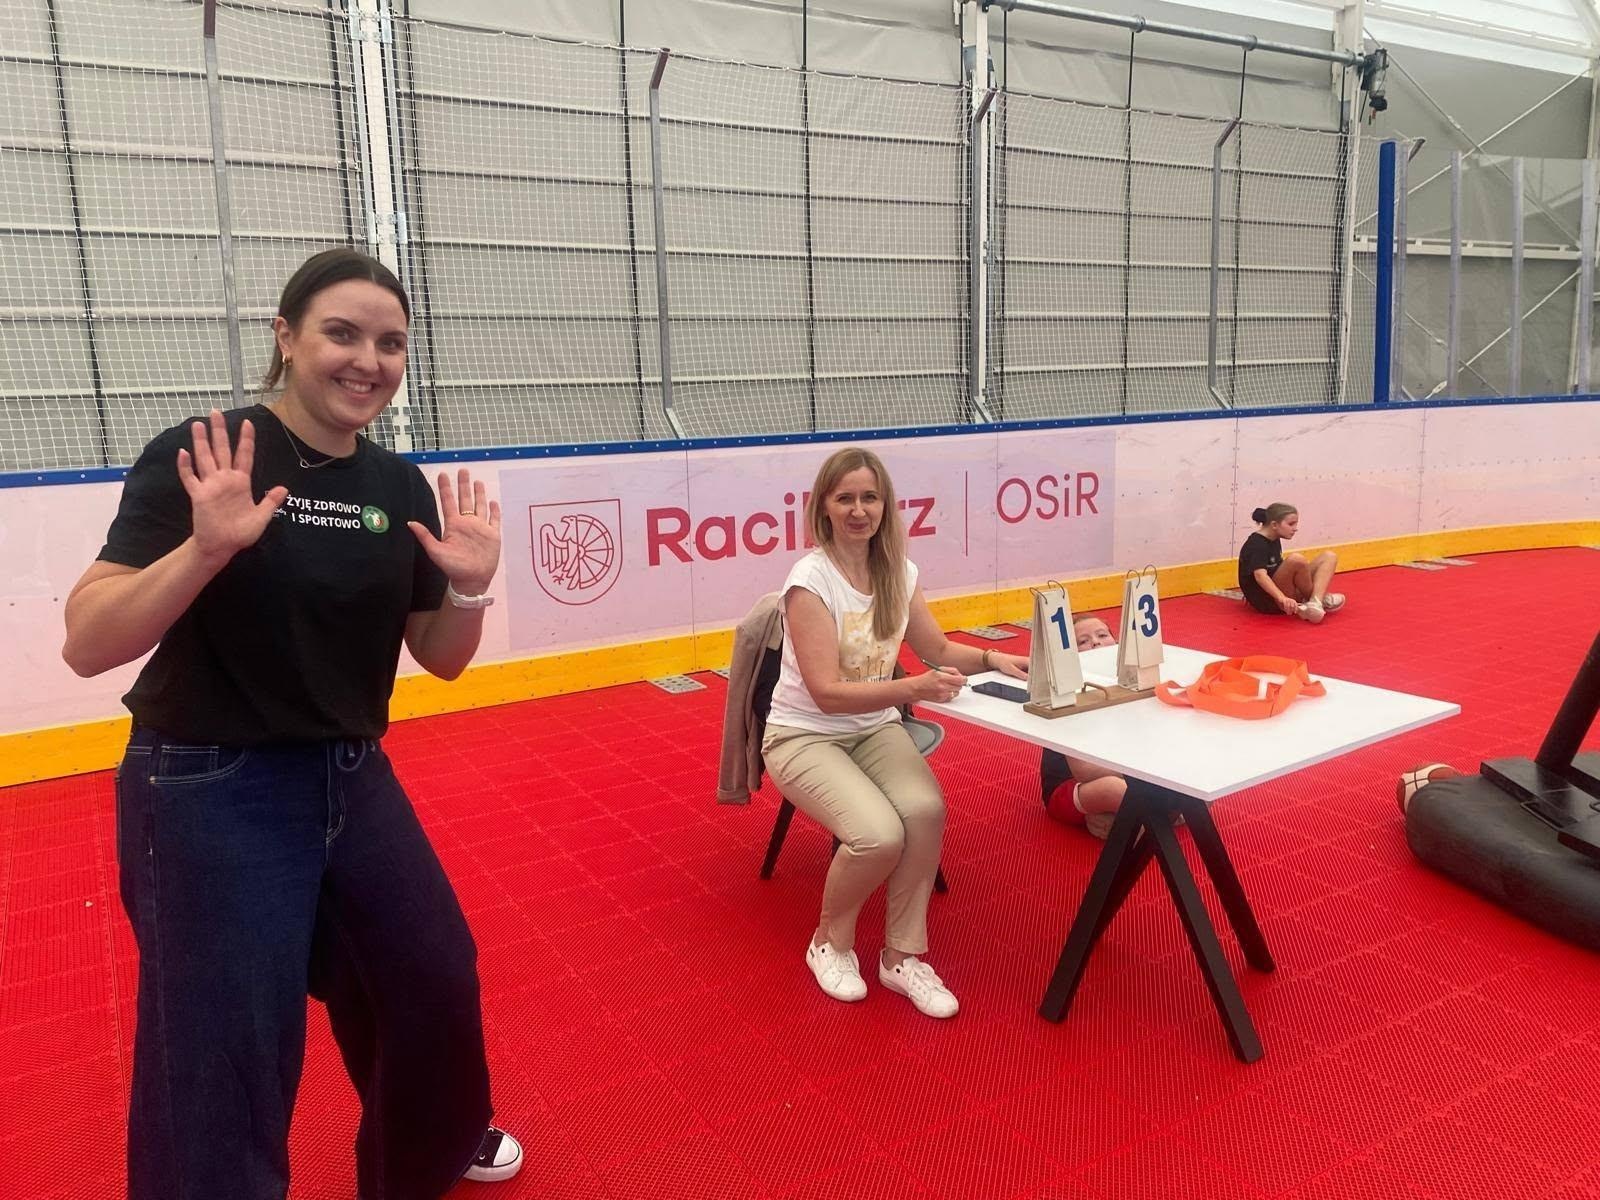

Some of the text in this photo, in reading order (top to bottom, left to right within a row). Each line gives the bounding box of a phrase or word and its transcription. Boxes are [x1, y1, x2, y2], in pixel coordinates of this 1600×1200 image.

[287, 494, 360, 513] ŻYJĘ ZDROWO
[291, 512, 296, 522] I
[300, 514, 360, 528] SPORTOWO
[646, 472, 1100, 567] Raciz OSiR
[1050, 606, 1070, 650] 1
[1138, 594, 1159, 638] 3
